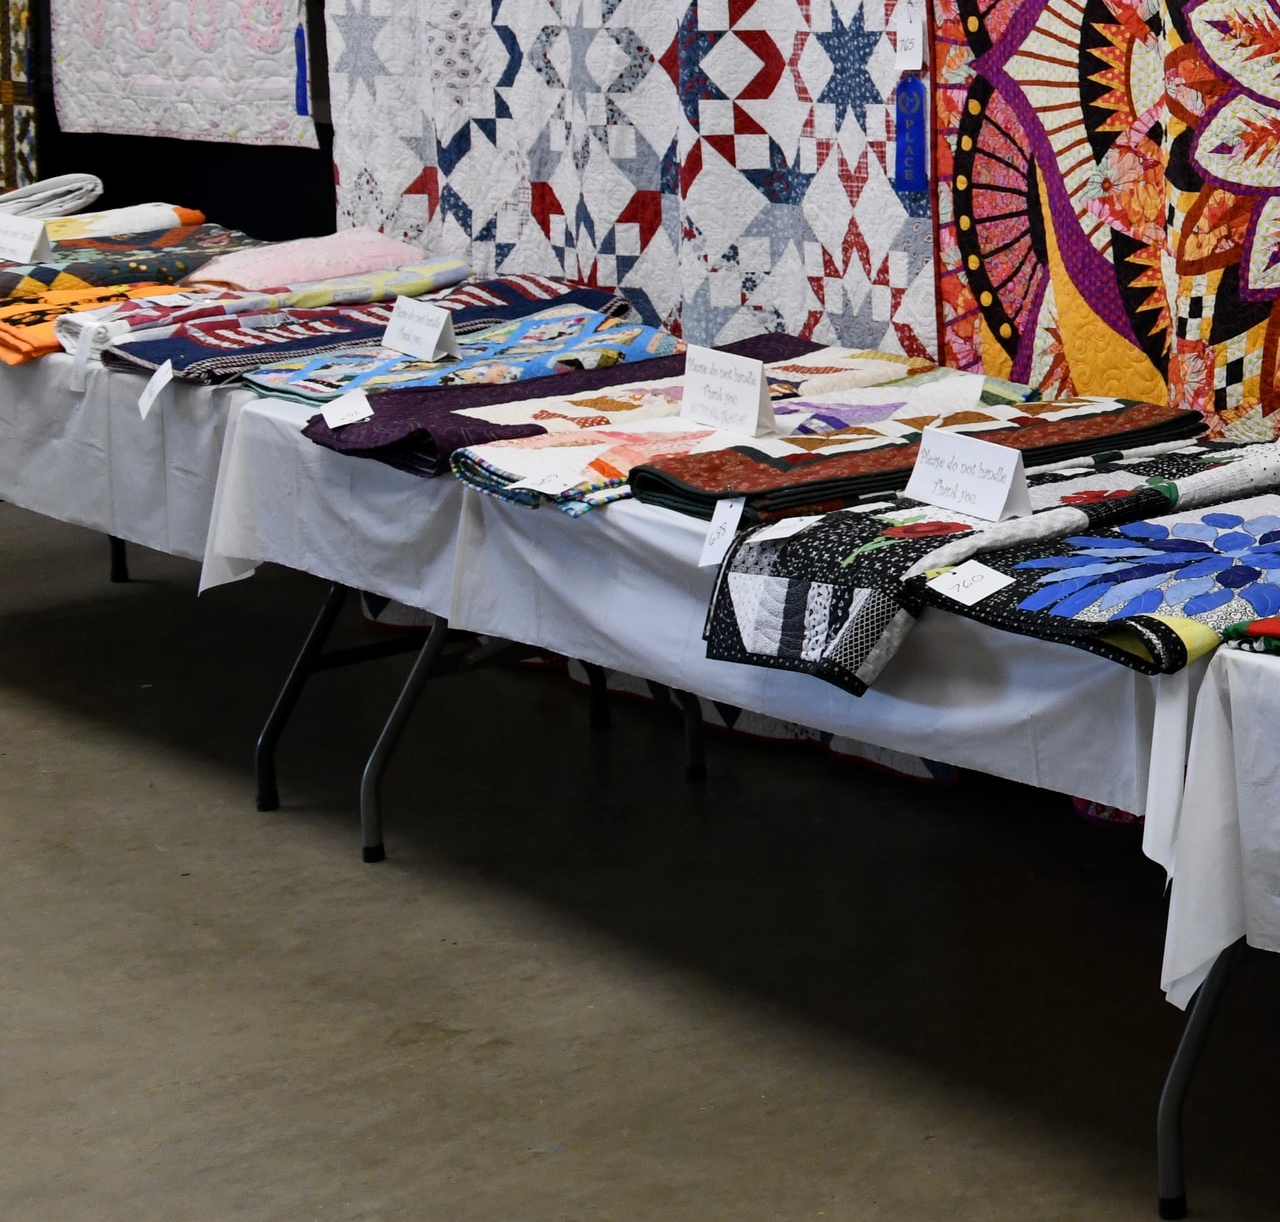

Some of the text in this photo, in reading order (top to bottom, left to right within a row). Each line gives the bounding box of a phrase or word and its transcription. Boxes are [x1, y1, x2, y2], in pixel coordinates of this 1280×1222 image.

[920, 448, 945, 468] Please
[947, 455, 958, 471] do
[960, 463, 976, 475] not
[933, 479, 959, 498] Thank
[948, 575, 984, 592] 760
